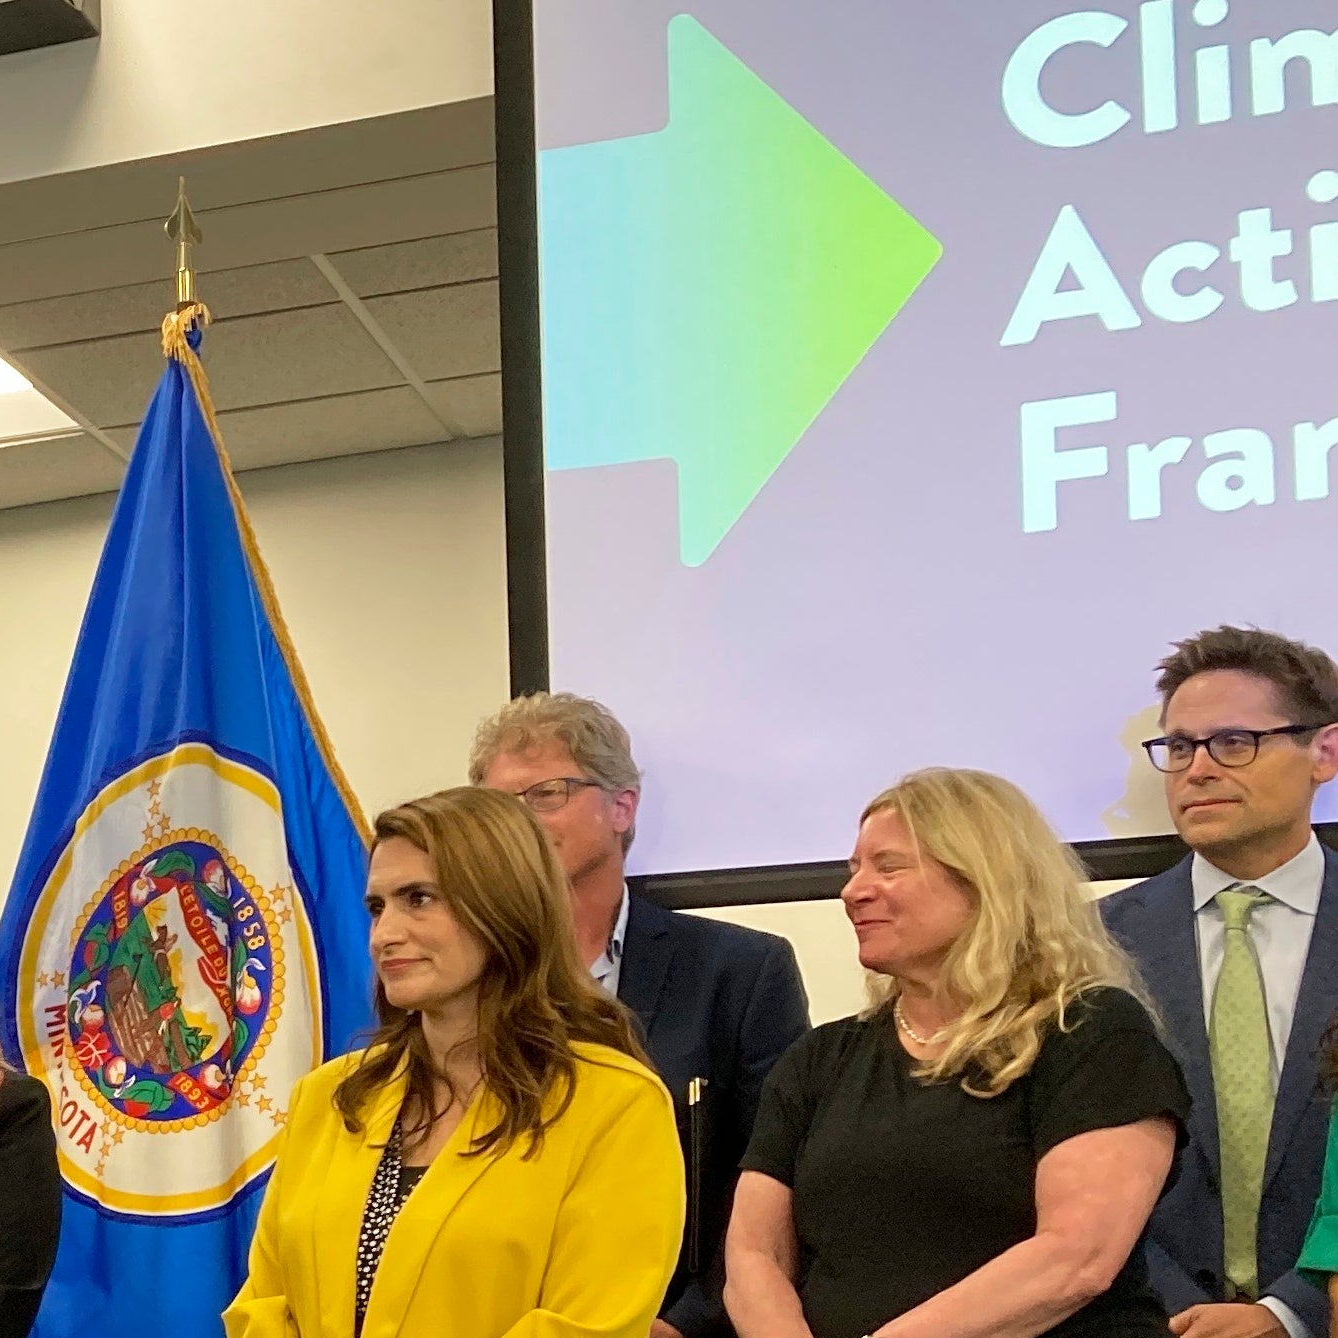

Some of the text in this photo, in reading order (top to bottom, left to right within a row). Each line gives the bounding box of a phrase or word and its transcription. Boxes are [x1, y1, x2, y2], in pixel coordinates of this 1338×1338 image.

[113, 891, 128, 929] 1819
[232, 896, 266, 950] 1858
[175, 1075, 210, 1111] 1893
